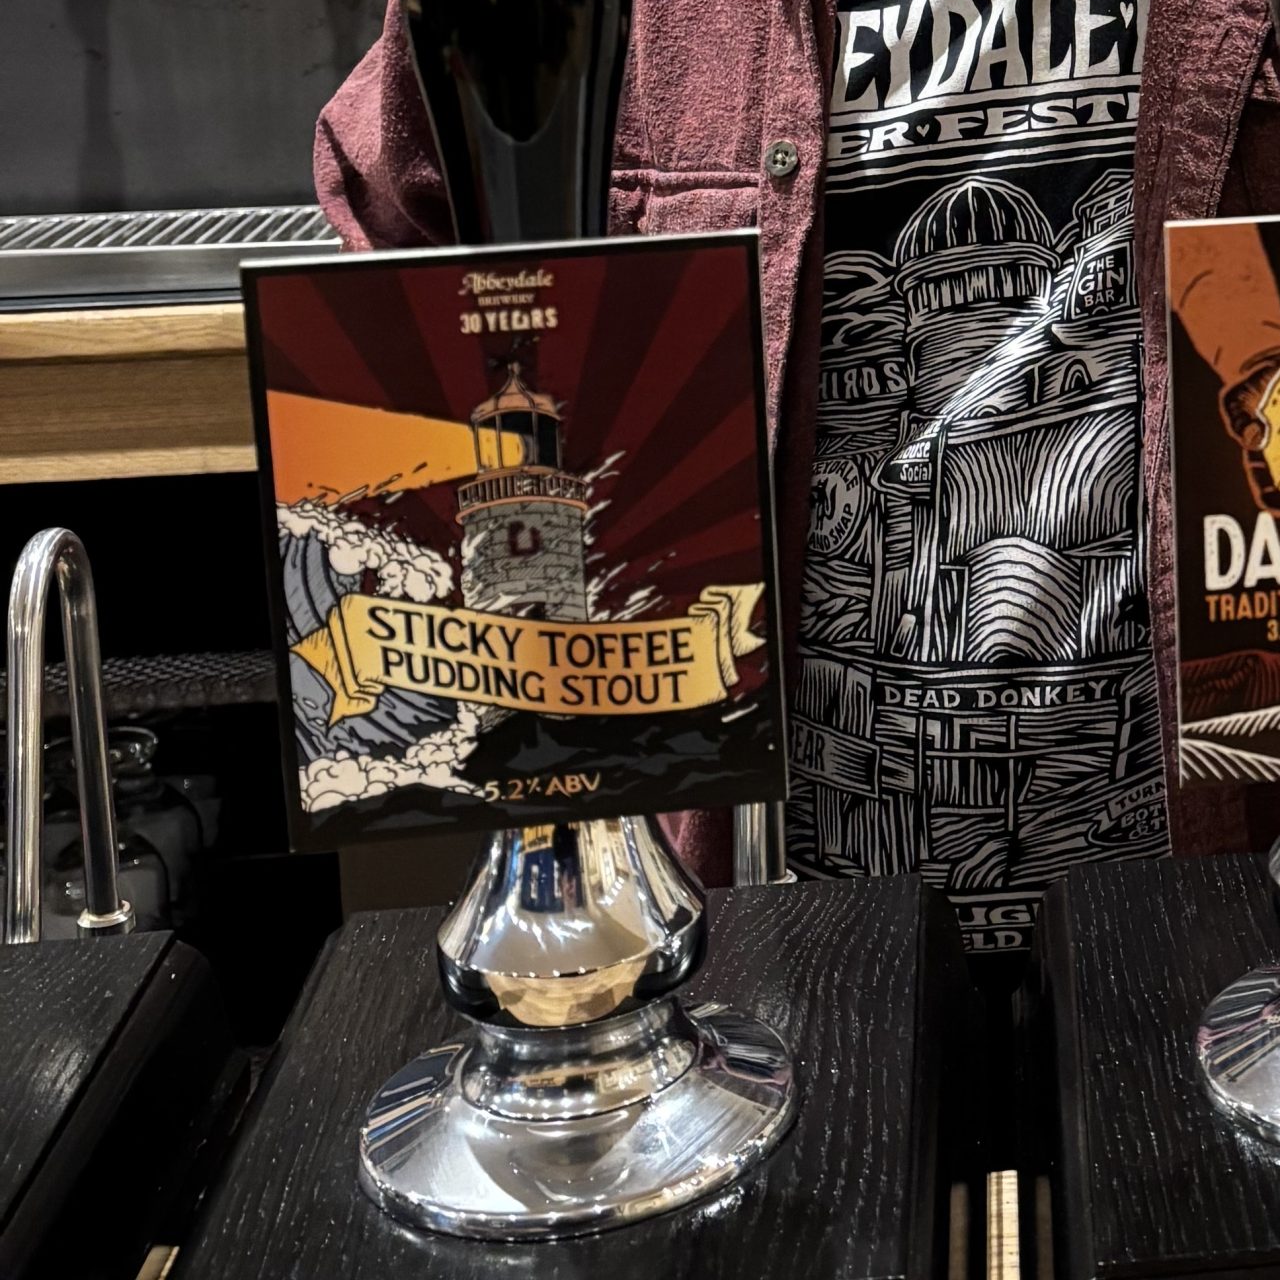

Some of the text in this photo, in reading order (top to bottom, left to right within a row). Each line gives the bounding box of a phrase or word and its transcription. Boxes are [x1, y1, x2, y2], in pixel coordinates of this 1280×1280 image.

[1086, 255, 1115, 273] THE
[458, 269, 554, 294] Abbeydale
[1078, 267, 1125, 295] GIN
[1083, 290, 1115, 307] BAR
[460, 313, 482, 334] 30
[900, 463, 932, 482] Social
[366, 606, 695, 669] STICKY TOFFEE
[380, 646, 688, 705] PUDDING STOUT
[885, 680, 1108, 708] DEAD DONKEY
[545, 773, 600, 797] ABV
